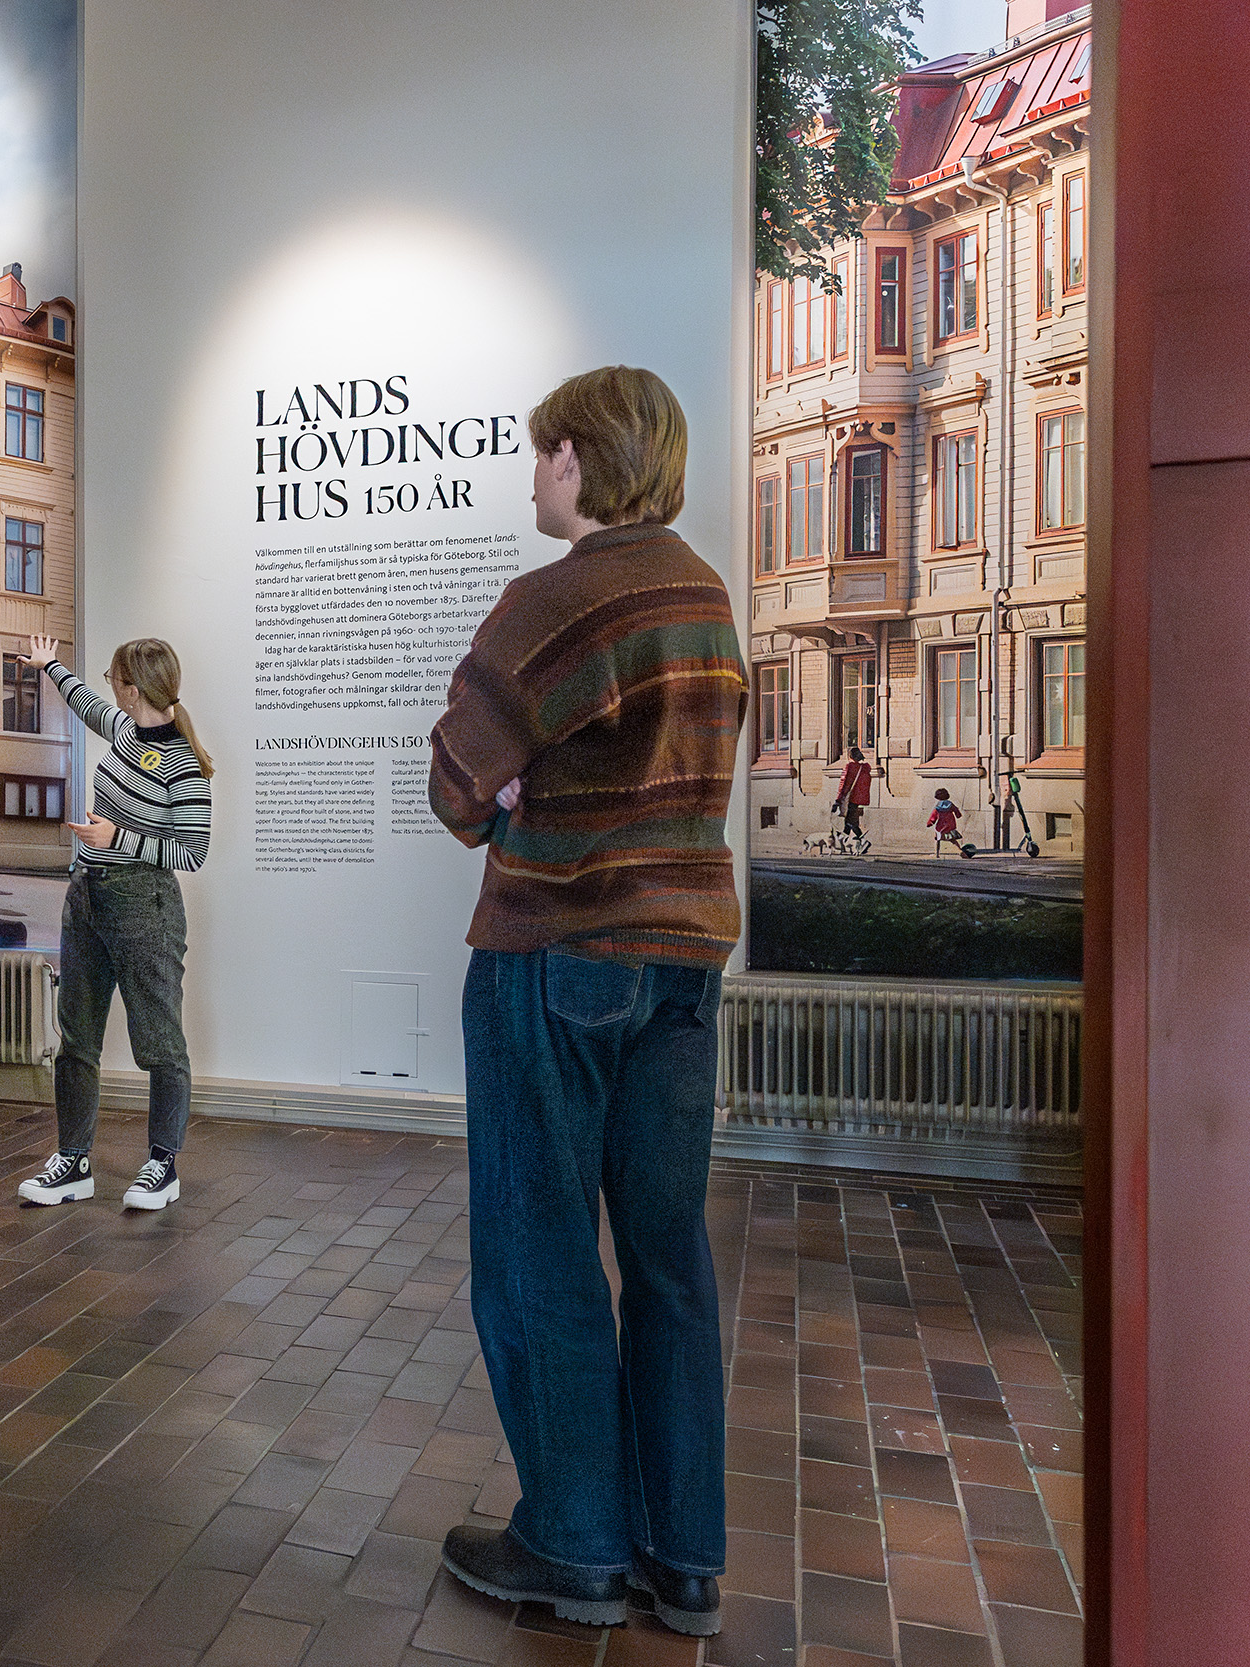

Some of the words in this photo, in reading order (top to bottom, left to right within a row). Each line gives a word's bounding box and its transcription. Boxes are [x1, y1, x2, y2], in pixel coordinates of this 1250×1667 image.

[256, 375, 410, 427] LANDS
[256, 415, 520, 475] HÖVDINGE
[256, 479, 349, 522] HUS
[364, 483, 419, 515] 150
[426, 473, 474, 510] ÅR
[255, 549, 302, 557] Välkommen
[328, 543, 372, 552] utställning
[394, 540, 427, 549] berättar
[445, 536, 492, 545] fenomenet
[494, 533, 519, 542] lands-
[255, 562, 303, 572] hövdingehus,
[305, 559, 358, 568] flerfamiljshus
[389, 555, 397, 563] så
[399, 554, 428, 564] typiska
[430, 552, 442, 560] för
[444, 551, 486, 560] Göteborg.
[488, 549, 502, 557] Stil
[504, 548, 519, 556] och
[256, 576, 289, 585] standard
[305, 573, 334, 582] varierat
[337, 572, 356, 580] brett
[358, 572, 385, 581] genom
[387, 569, 408, 578] åren,
[460, 564, 519, 576] gemensamma
[256, 590, 290, 599] nämnare
[300, 588, 320, 596] alltid
[334, 585, 387, 594] bottenvåning
[393, 584, 410, 592] sten
[413, 582, 427, 591] och
[430, 581, 442, 589] två
[444, 580, 480, 590] våningar
[256, 604, 278, 613] första
[281, 603, 319, 614] bygglovet
[321, 600, 365, 609] utfärdades
[396, 596, 437, 606] november
[440, 596, 459, 605] 1875.
[256, 616, 334, 627] landshövdingehusen
[336, 615, 347, 623] att
[349, 614, 386, 622] dominera
[388, 612, 431, 621] Göteborgs
[434, 608, 490, 618] arbetarkvarte
[255, 632, 296, 640] decennier,
[323, 628, 379, 639] rivningsvågen
[382, 627, 391, 637] på
[394, 627, 415, 636] 1960-
[418, 626, 433, 634] och
[265, 646, 281, 655] Idag
[309, 643, 367, 652] karaktäristiska
[369, 642, 393, 650] husen
[395, 642, 411, 651] hög
[255, 661, 273, 670] äger
[287, 659, 319, 669] självklar
[321, 659, 340, 668] plats
[347, 656, 393, 665] stadsbilden
[403, 655, 414, 663] för
[274, 672, 349, 682] landshövdingehus?
[352, 671, 382, 679] Genom
[385, 670, 423, 678] modeller,
[283, 686, 326, 697] fotografier
[328, 686, 343, 694] och
[346, 685, 388, 695] målningar
[391, 683, 422, 692] skildrar
[425, 683, 440, 691] den
[256, 701, 341, 711] landshövdingehusens
[343, 699, 386, 709] uppkomst,
[389, 698, 401, 706] fall
[256, 735, 399, 750] LANDSHÖVDINGEHUS
[402, 736, 423, 748] 150
